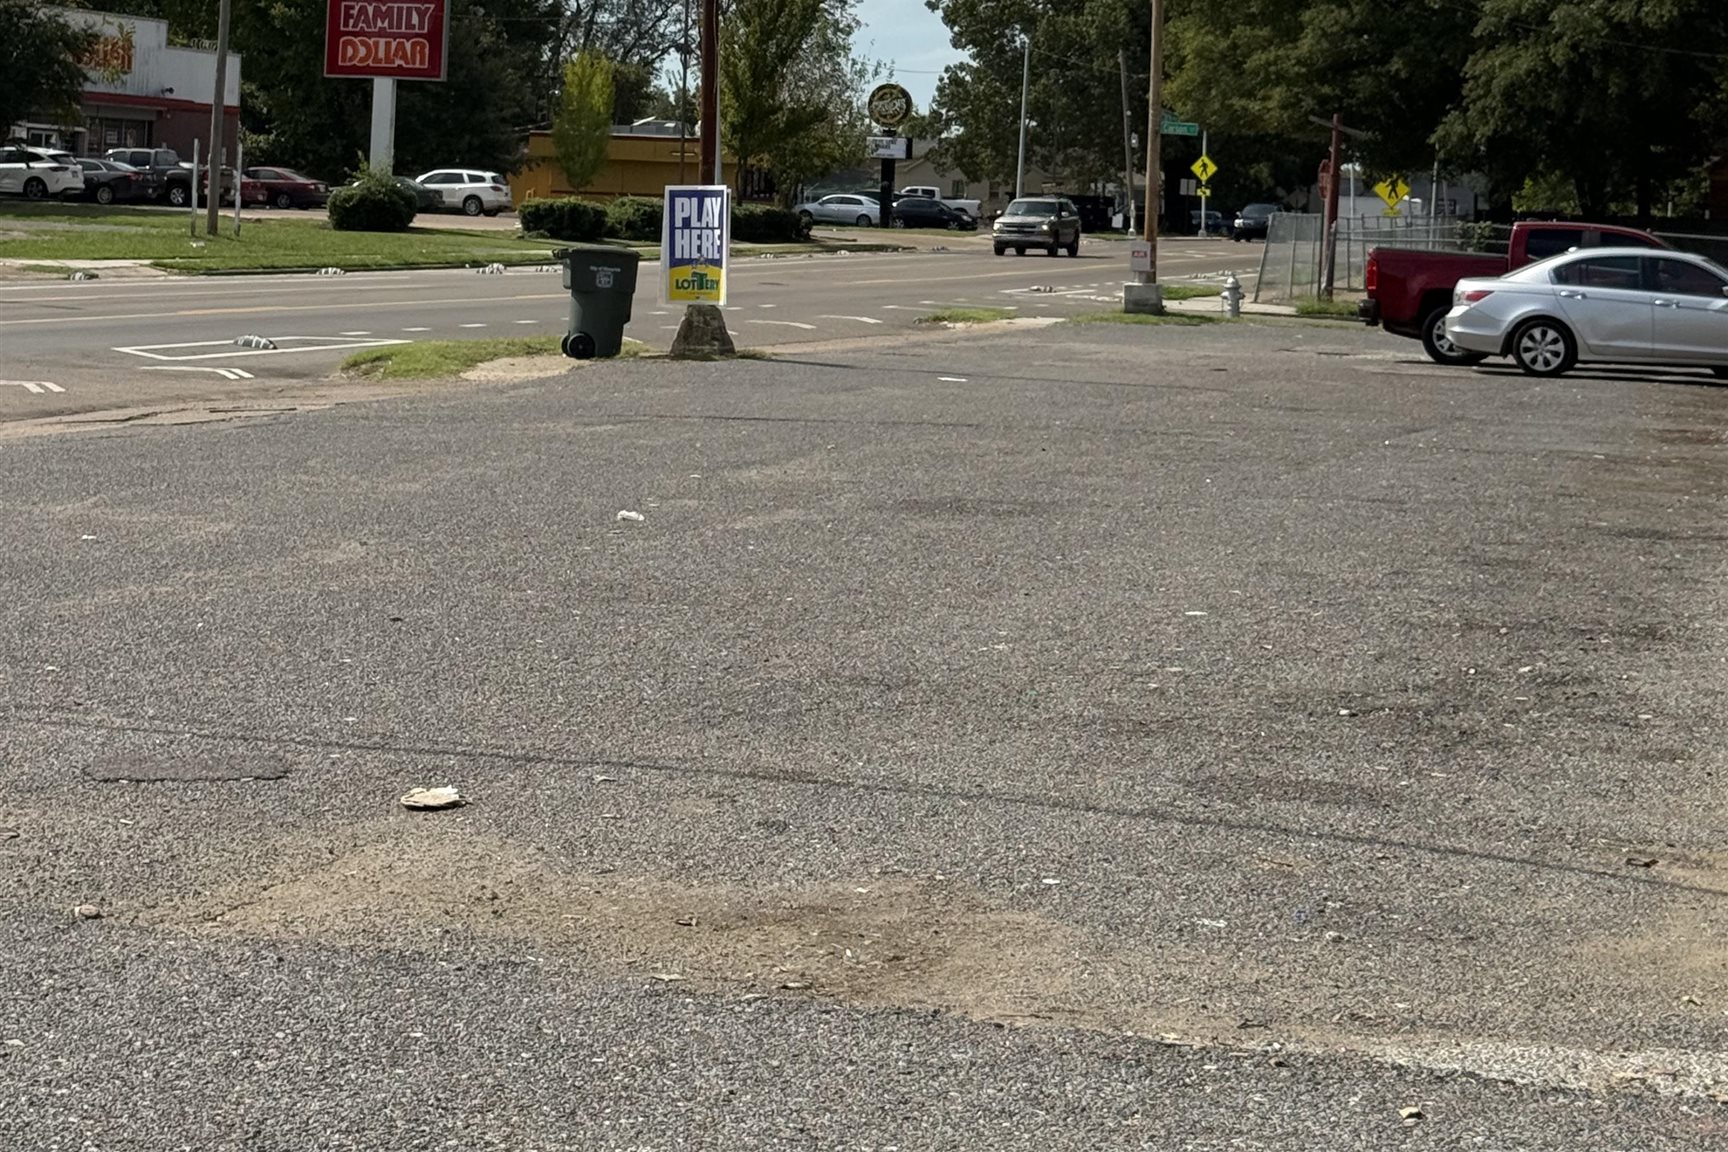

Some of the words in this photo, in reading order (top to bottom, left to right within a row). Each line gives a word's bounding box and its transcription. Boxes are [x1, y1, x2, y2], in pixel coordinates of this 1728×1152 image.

[340, 1, 435, 33] FAMILY
[338, 36, 429, 68] DOLLAR
[675, 197, 721, 228] PLAY
[675, 229, 721, 259] HERE
[675, 271, 720, 290] LOTTERY
